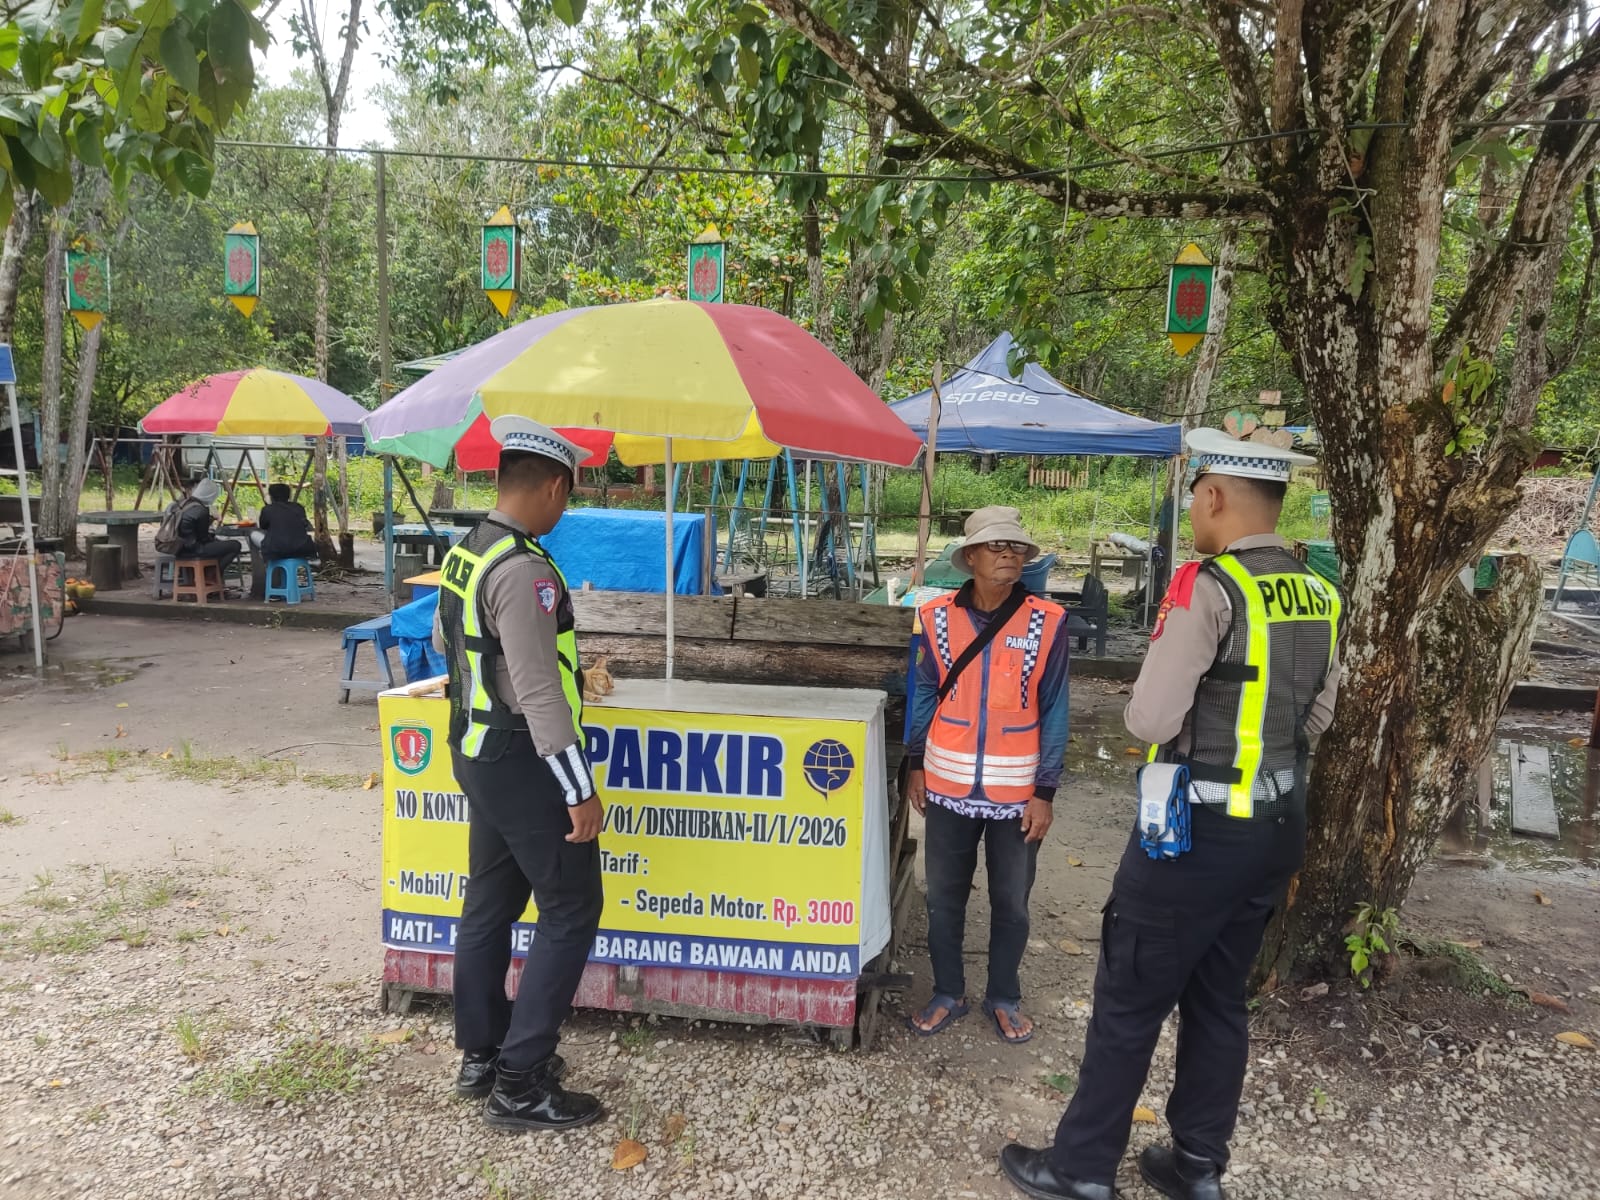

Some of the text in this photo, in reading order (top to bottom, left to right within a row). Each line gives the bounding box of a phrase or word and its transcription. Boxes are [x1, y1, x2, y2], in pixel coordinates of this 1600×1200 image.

[943, 390, 1041, 406] speeds
[1006, 636, 1040, 651] PARKIR
[581, 726, 784, 798] PARKIR
[396, 789, 847, 847] NO KONT /01/DISHUBKAN-II/I/2026
[601, 850, 639, 875] Tarif
[400, 870, 454, 901] Mobil/
[636, 889, 704, 919] Sepeda
[710, 894, 768, 921] Motor.
[773, 898, 801, 927] Rp.
[808, 901, 854, 925] 3000
[390, 917, 443, 944] HATI-
[594, 935, 682, 964] BARANG
[690, 942, 784, 972] BAWAAN
[791, 948, 852, 974] ANDA
